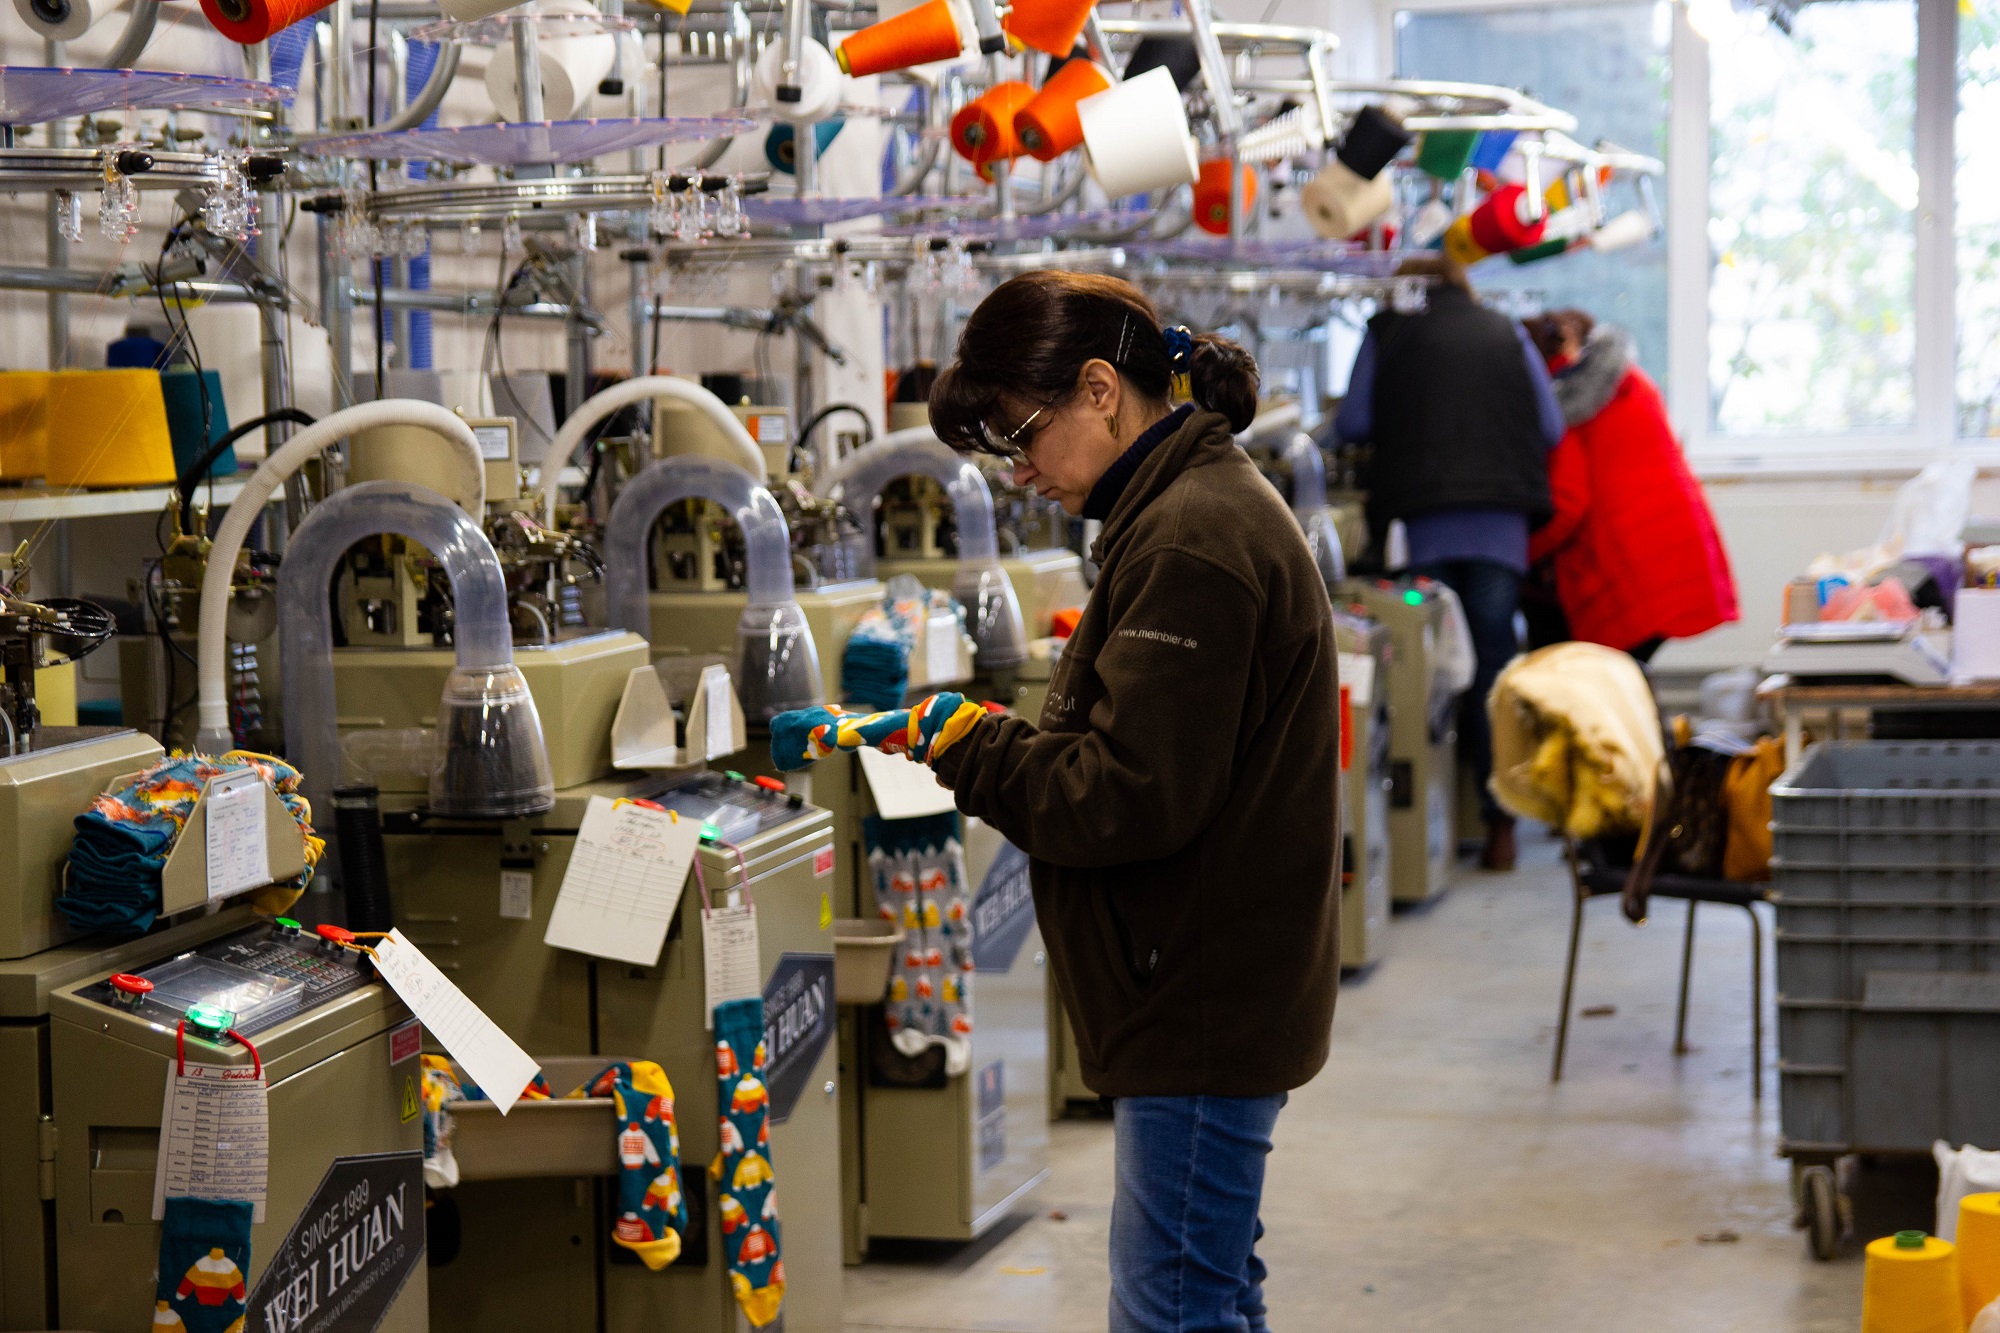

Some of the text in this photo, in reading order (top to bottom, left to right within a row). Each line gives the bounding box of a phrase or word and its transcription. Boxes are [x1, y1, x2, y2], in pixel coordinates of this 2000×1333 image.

[1118, 628, 1198, 649] www.meinbier.de
[264, 1182, 406, 1333] WEI HUAN
[301, 1178, 369, 1259] SINCE 1999
